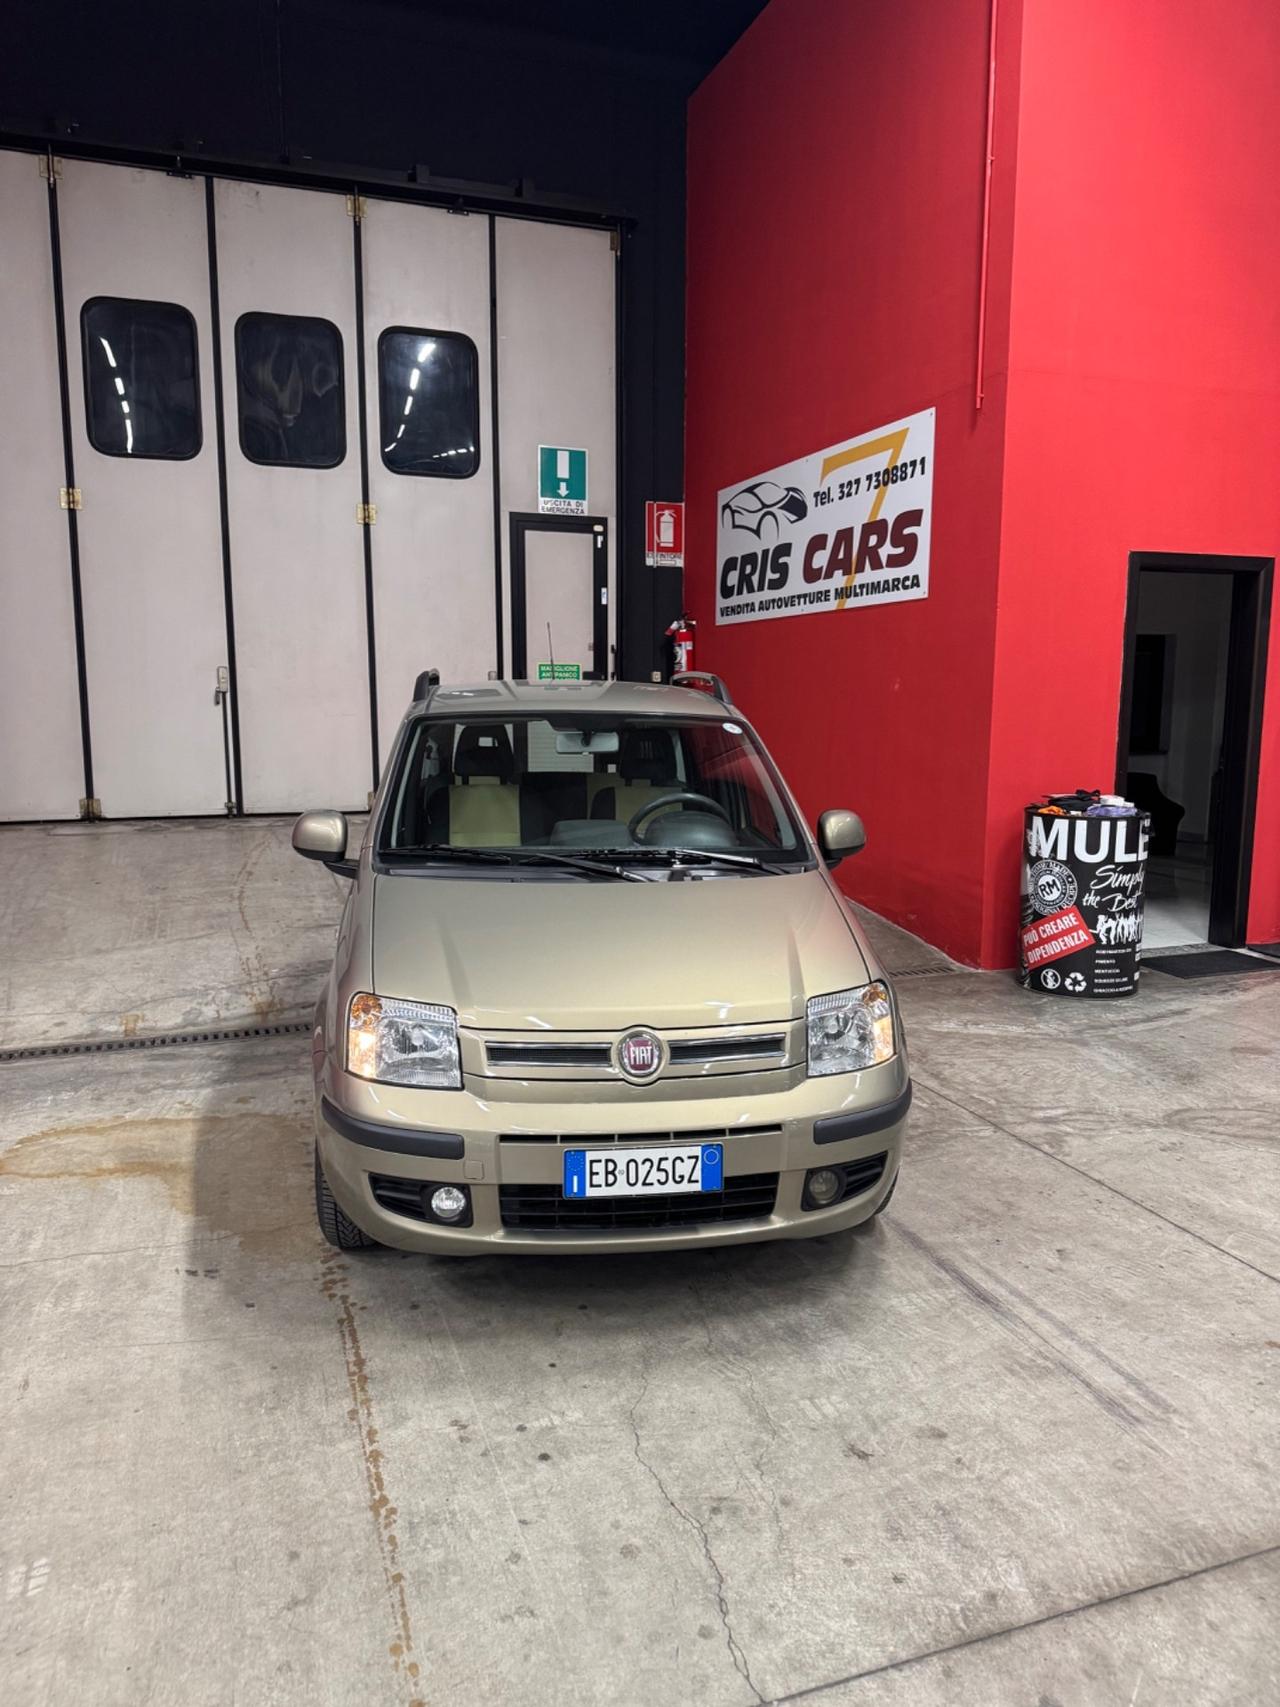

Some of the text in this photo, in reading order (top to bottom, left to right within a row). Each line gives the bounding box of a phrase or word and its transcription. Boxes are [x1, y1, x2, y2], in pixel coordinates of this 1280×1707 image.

[813, 456, 927, 508] Tel. 327 7308871
[541, 506, 585, 514] EMERGENZA
[719, 508, 924, 599] CRIS CARS
[720, 574, 921, 618] VENDITA AUTOVETTURE MULTIMARCA
[1038, 878, 1060, 898] RM
[1082, 889, 1101, 908] the
[1038, 912, 1079, 938] CREARE
[1027, 929, 1089, 963] DIPENDENZA
[630, 1045, 653, 1065] FIAT
[589, 1155, 700, 1189] EB 025GZ
